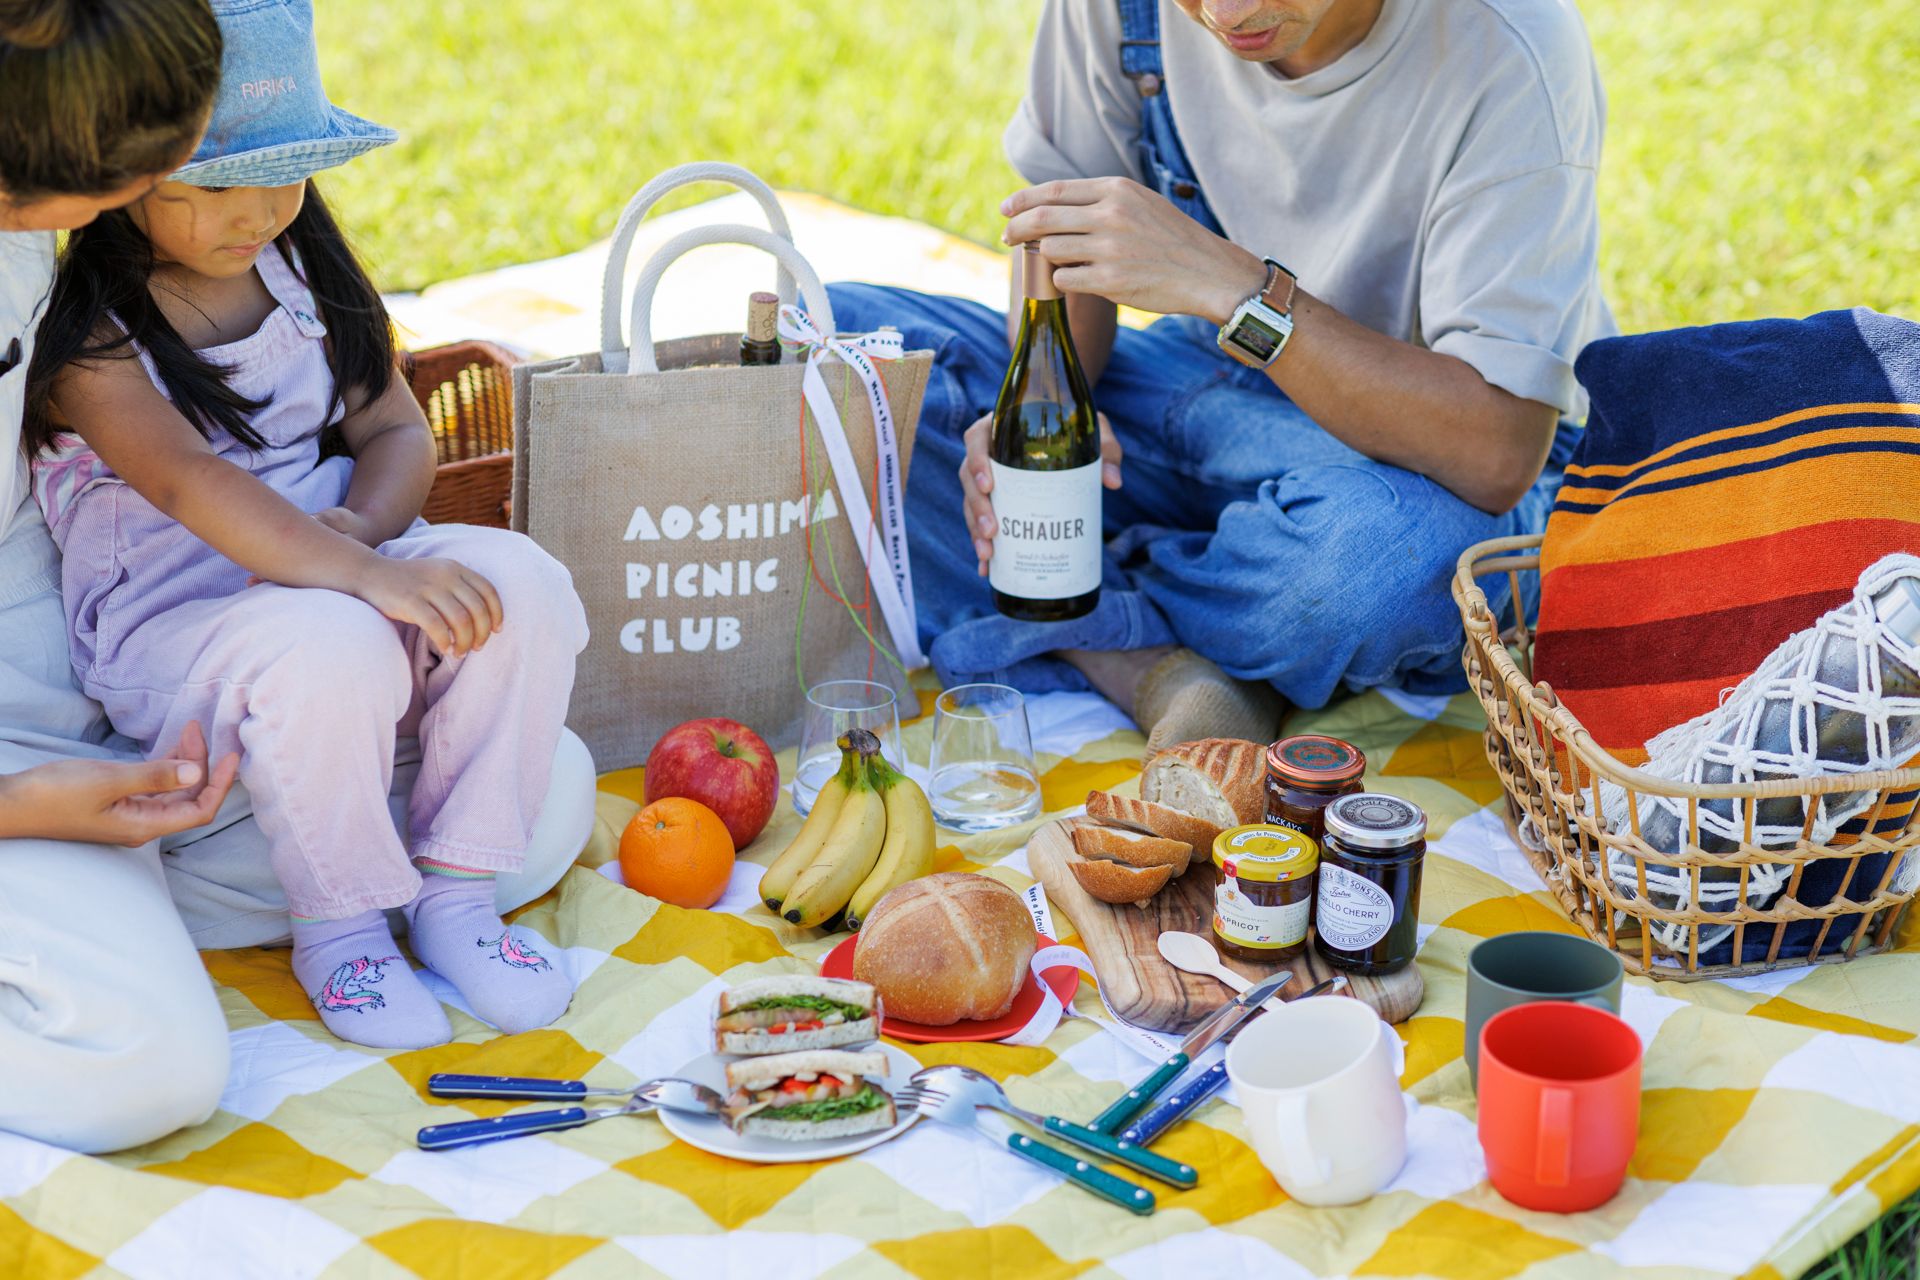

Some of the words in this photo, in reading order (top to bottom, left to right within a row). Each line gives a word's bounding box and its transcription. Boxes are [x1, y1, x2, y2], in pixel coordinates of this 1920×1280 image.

[240, 75, 298, 100] RIRIKA
[623, 489, 839, 541] AOSHIMA
[1002, 517, 1084, 541] SCHAUER
[626, 558, 779, 599] PICNIC
[620, 616, 742, 653] CLUB
[1028, 886, 1038, 902] Have
[1350, 880, 1371, 896] SONS
[1370, 892, 1384, 905] LTD
[1222, 914, 1260, 932] APRICOT
[1343, 907, 1380, 919] CHERRY
